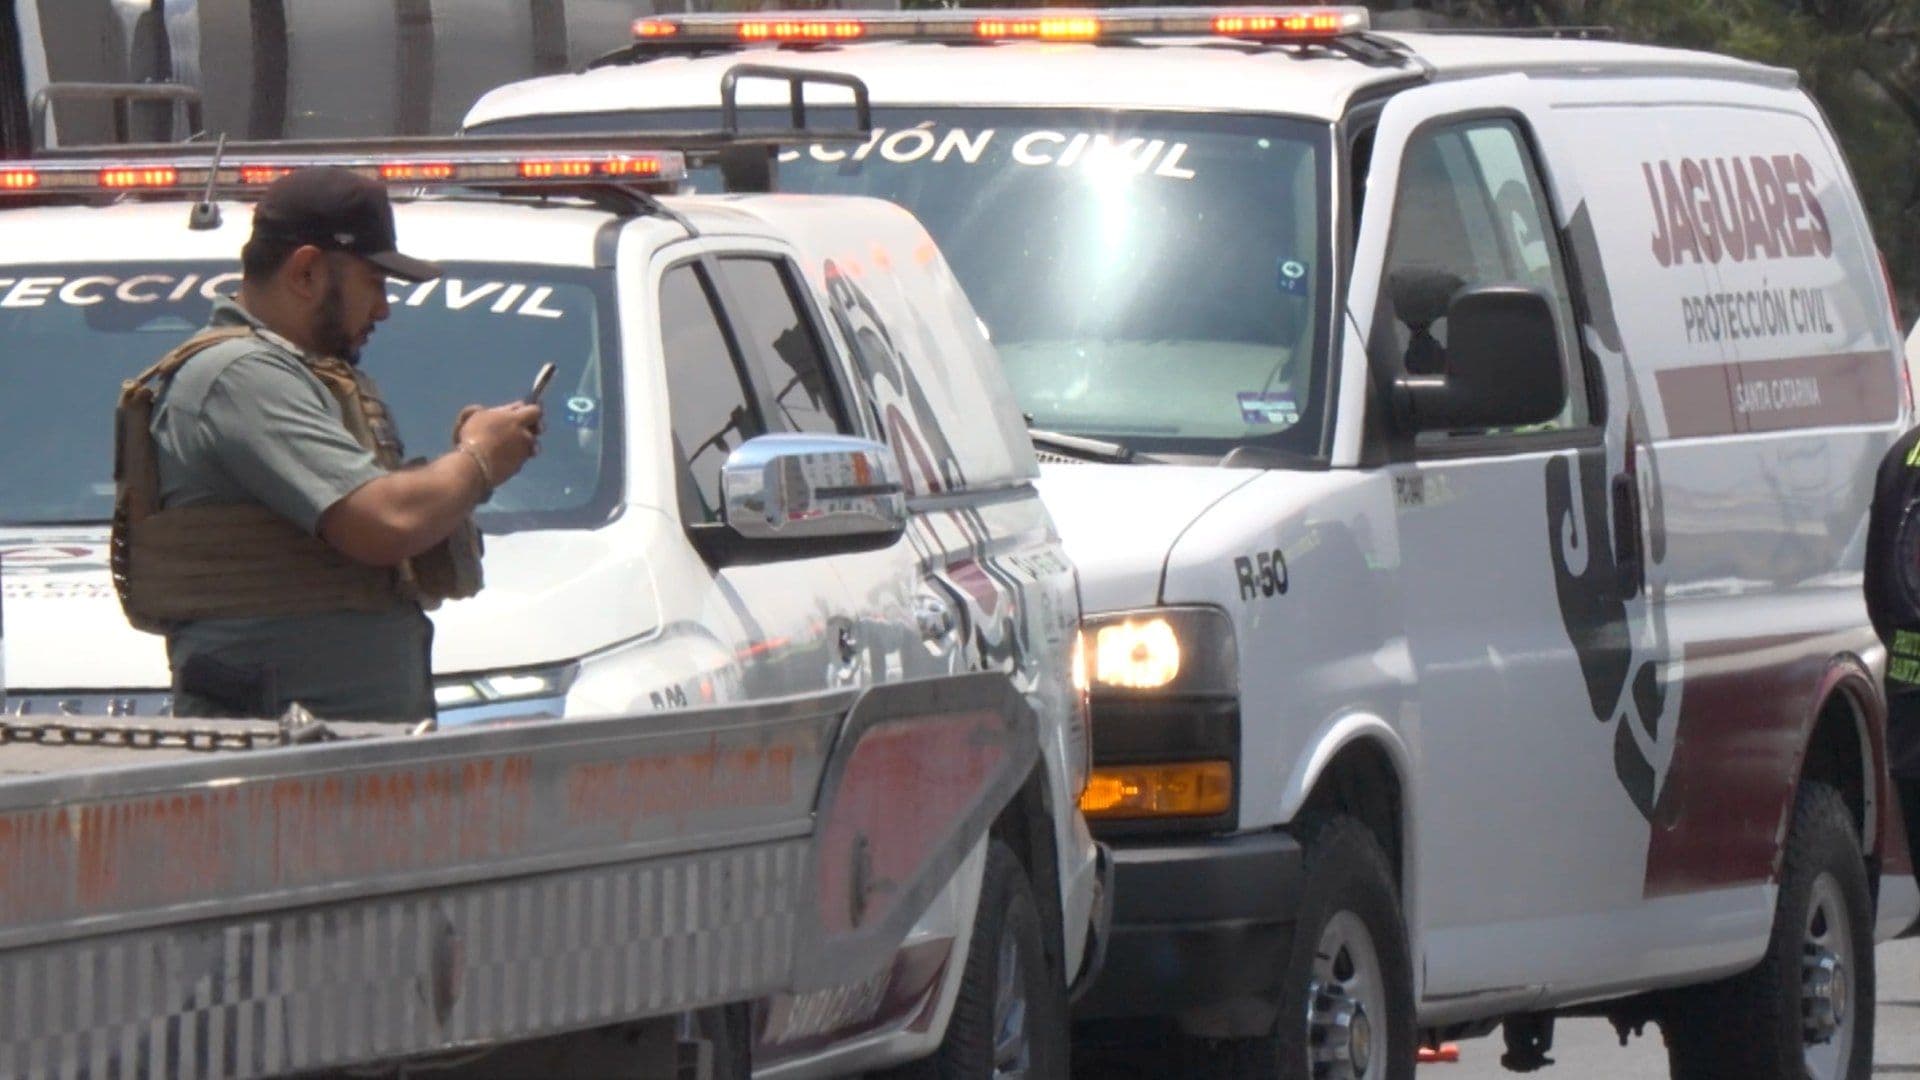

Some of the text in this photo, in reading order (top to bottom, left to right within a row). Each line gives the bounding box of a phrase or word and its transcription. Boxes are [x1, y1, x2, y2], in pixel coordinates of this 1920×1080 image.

[1011, 130, 1197, 180] CIVIL
[1641, 153, 1834, 269] JAGUARES
[1681, 277, 1834, 344] PROTECCIÓN CIVIL
[1234, 547, 1289, 602] R-50
